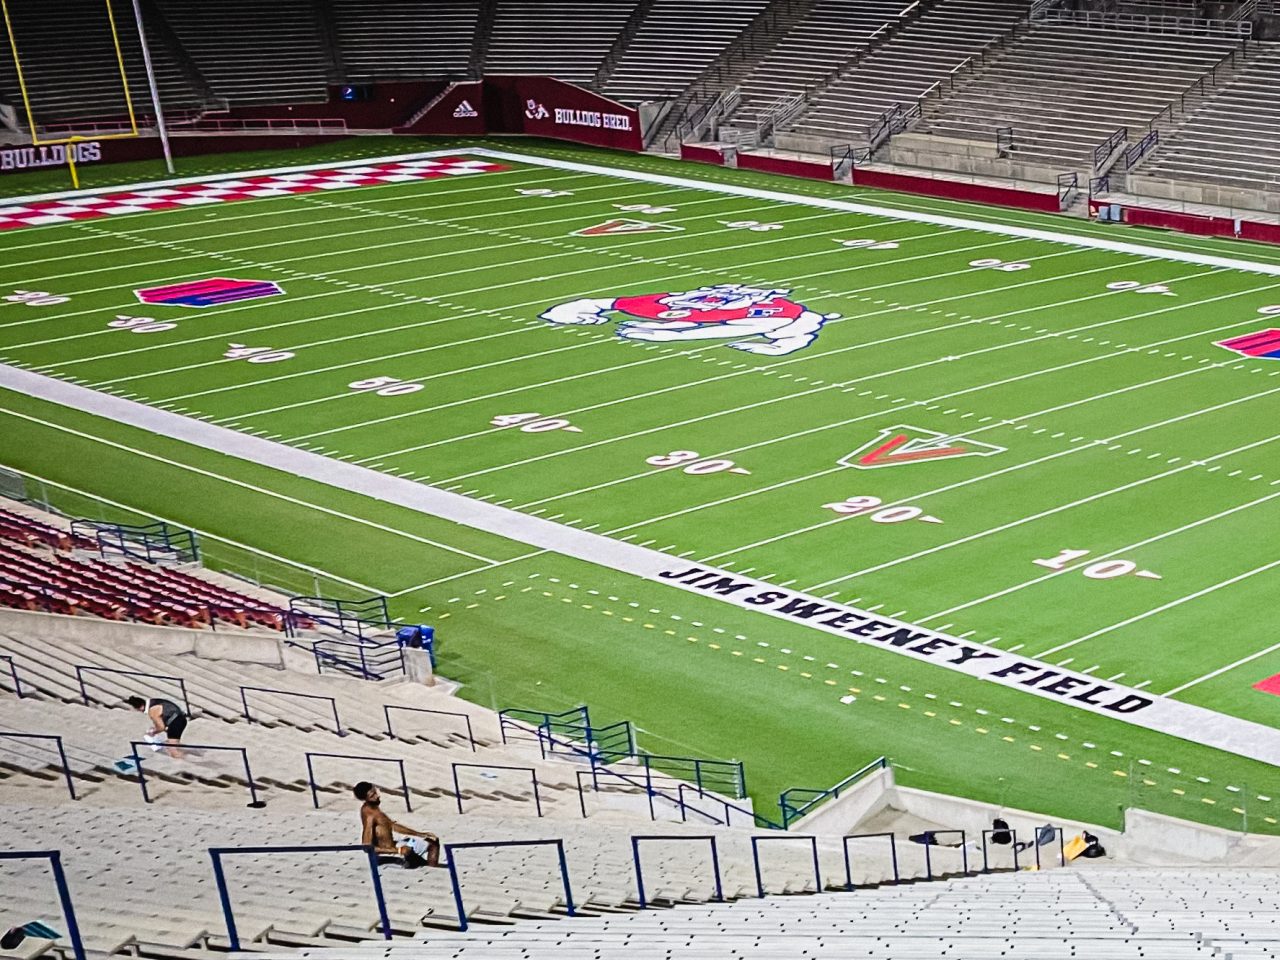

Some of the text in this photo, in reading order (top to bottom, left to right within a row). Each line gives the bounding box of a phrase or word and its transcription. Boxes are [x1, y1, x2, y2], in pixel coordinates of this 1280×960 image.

[555, 108, 601, 128] BULLDOG
[107, 316, 178, 333] 30
[223, 346, 295, 364] 40
[348, 376, 425, 396] 50
[490, 413, 570, 433] 40
[645, 451, 735, 475] 30
[821, 496, 923, 523] 20
[1032, 550, 1137, 579] 10
[659, 567, 1155, 715] JIM SWEENEY FIELD
